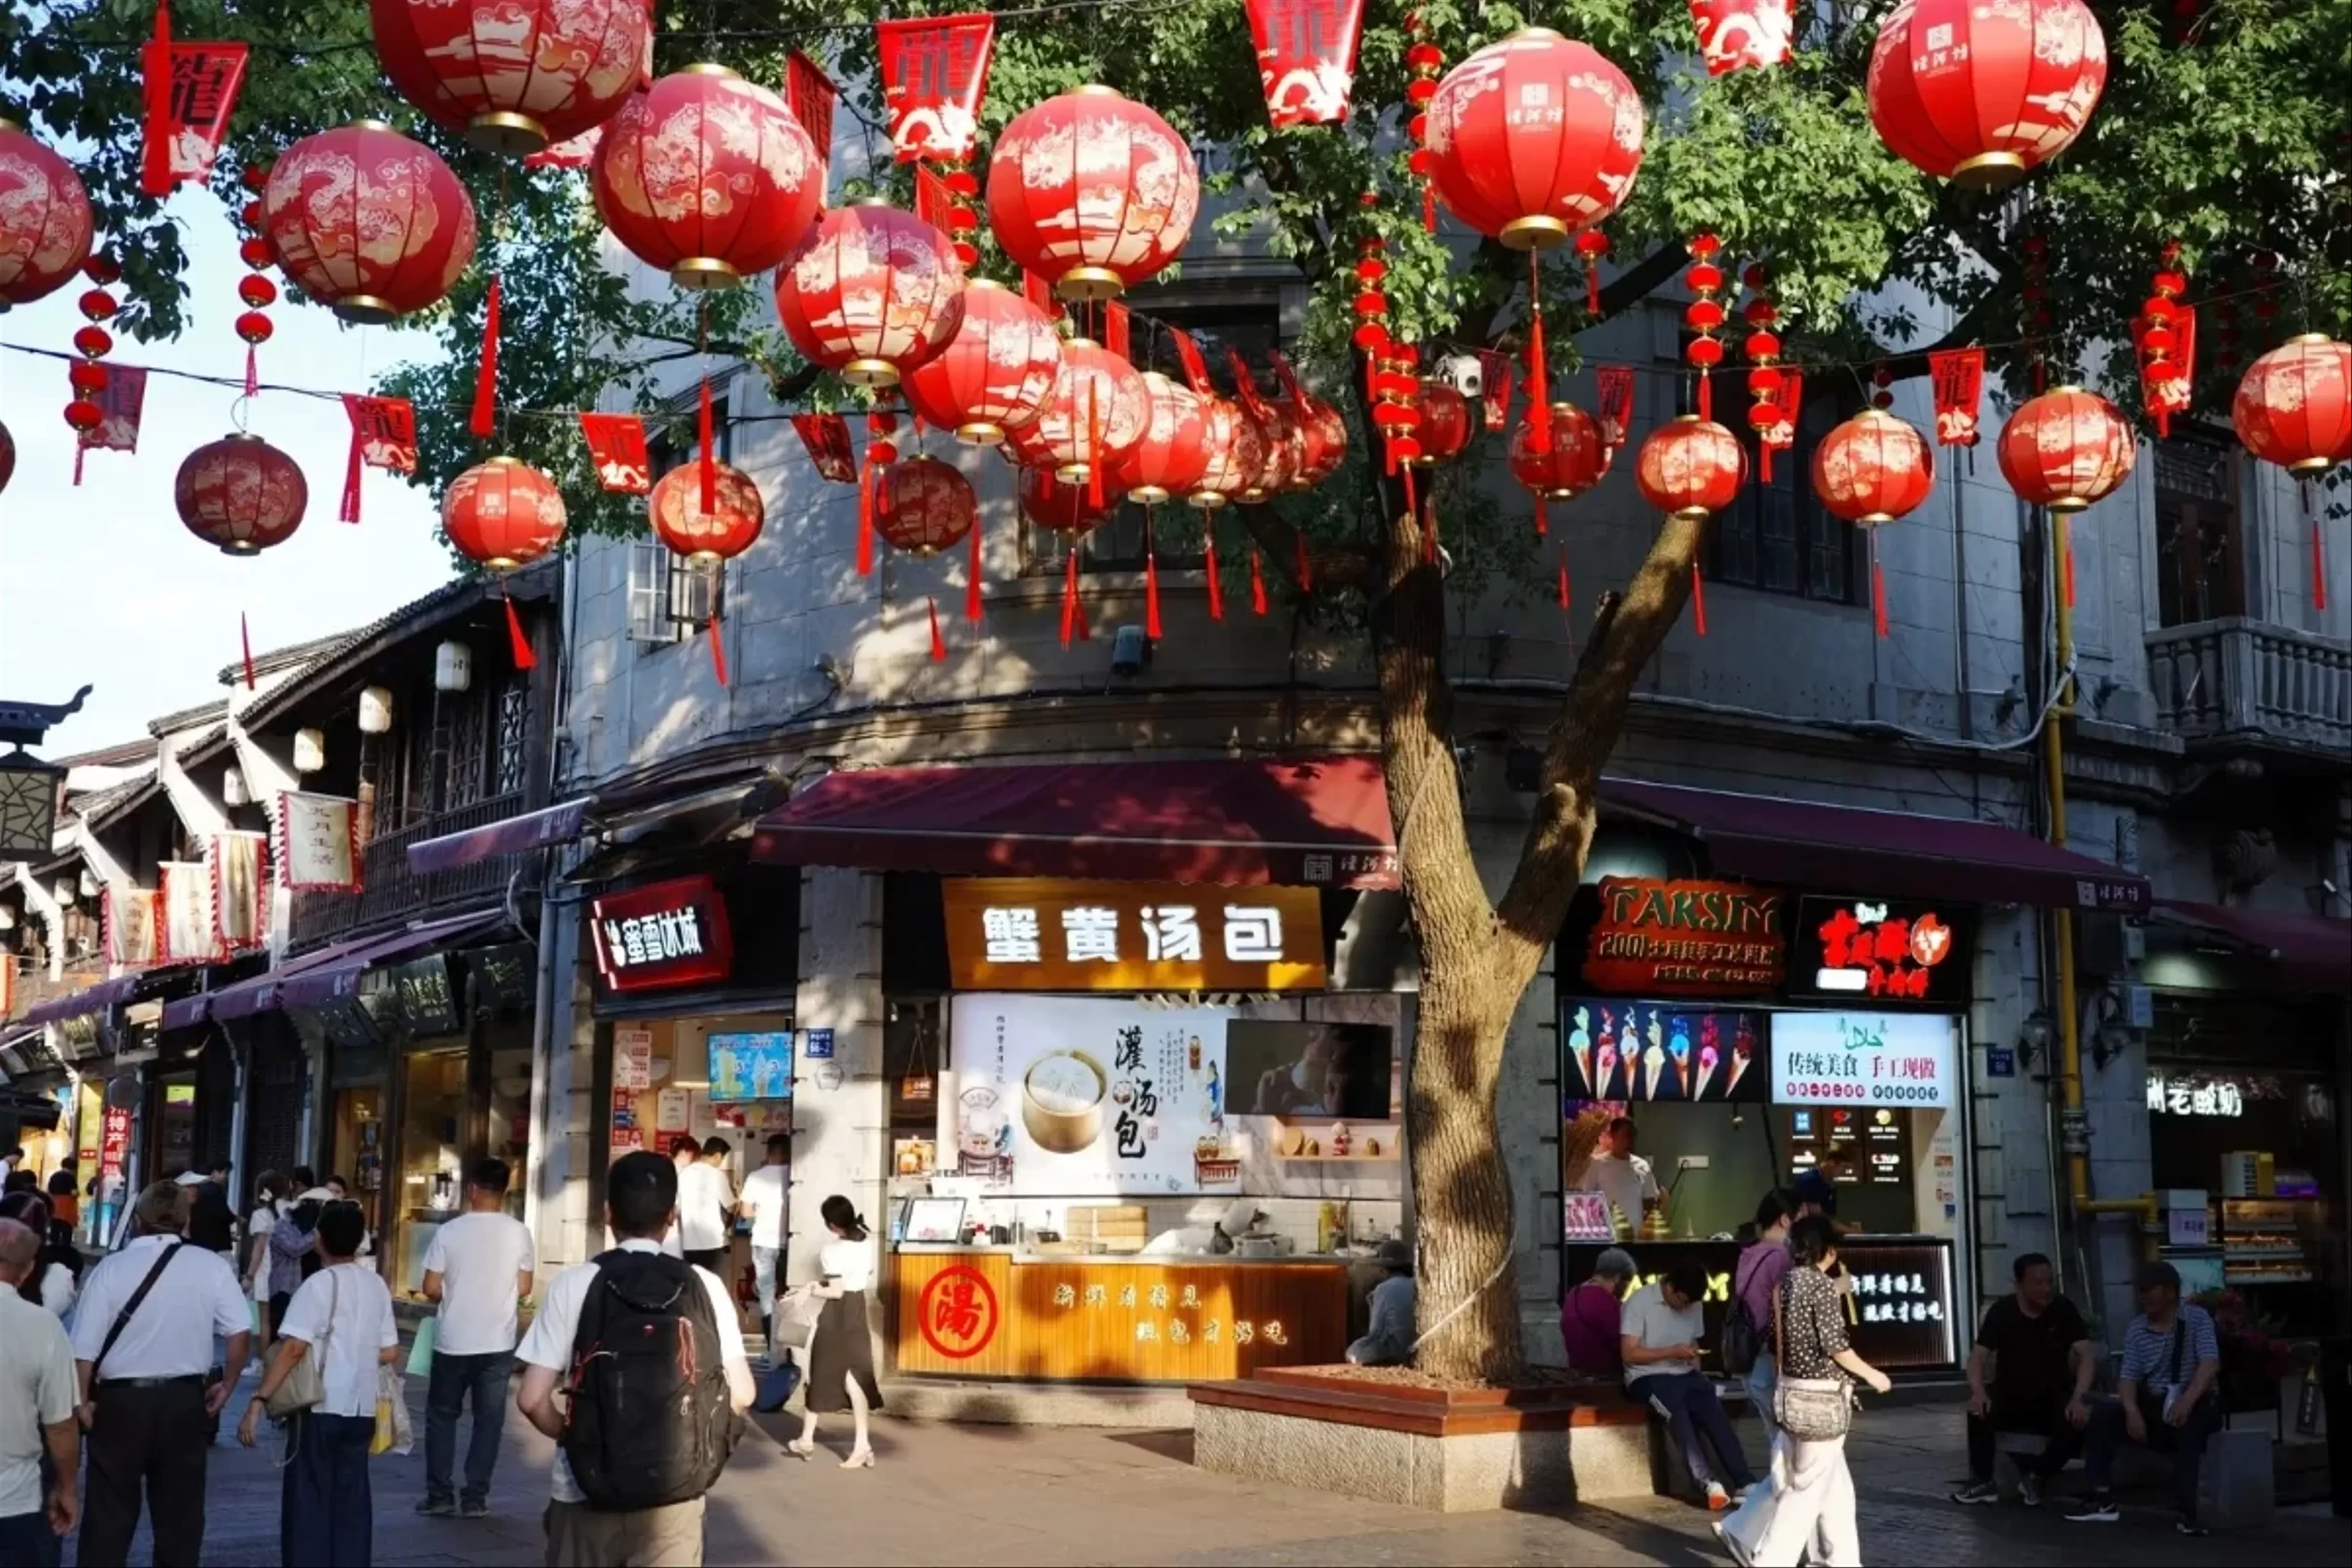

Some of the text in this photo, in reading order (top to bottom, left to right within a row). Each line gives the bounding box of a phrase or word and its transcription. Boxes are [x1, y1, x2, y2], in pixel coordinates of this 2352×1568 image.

[622, 906, 704, 964] 蜜雪冰城
[982, 905, 1284, 963] 蟹黄汤包
[1114, 1024, 1157, 1159] 灌汤包
[1789, 1052, 1936, 1080] 传统美食 手工现做
[935, 1284, 982, 1341] 湯
[1053, 1283, 1201, 1308] 新鲜看得见
